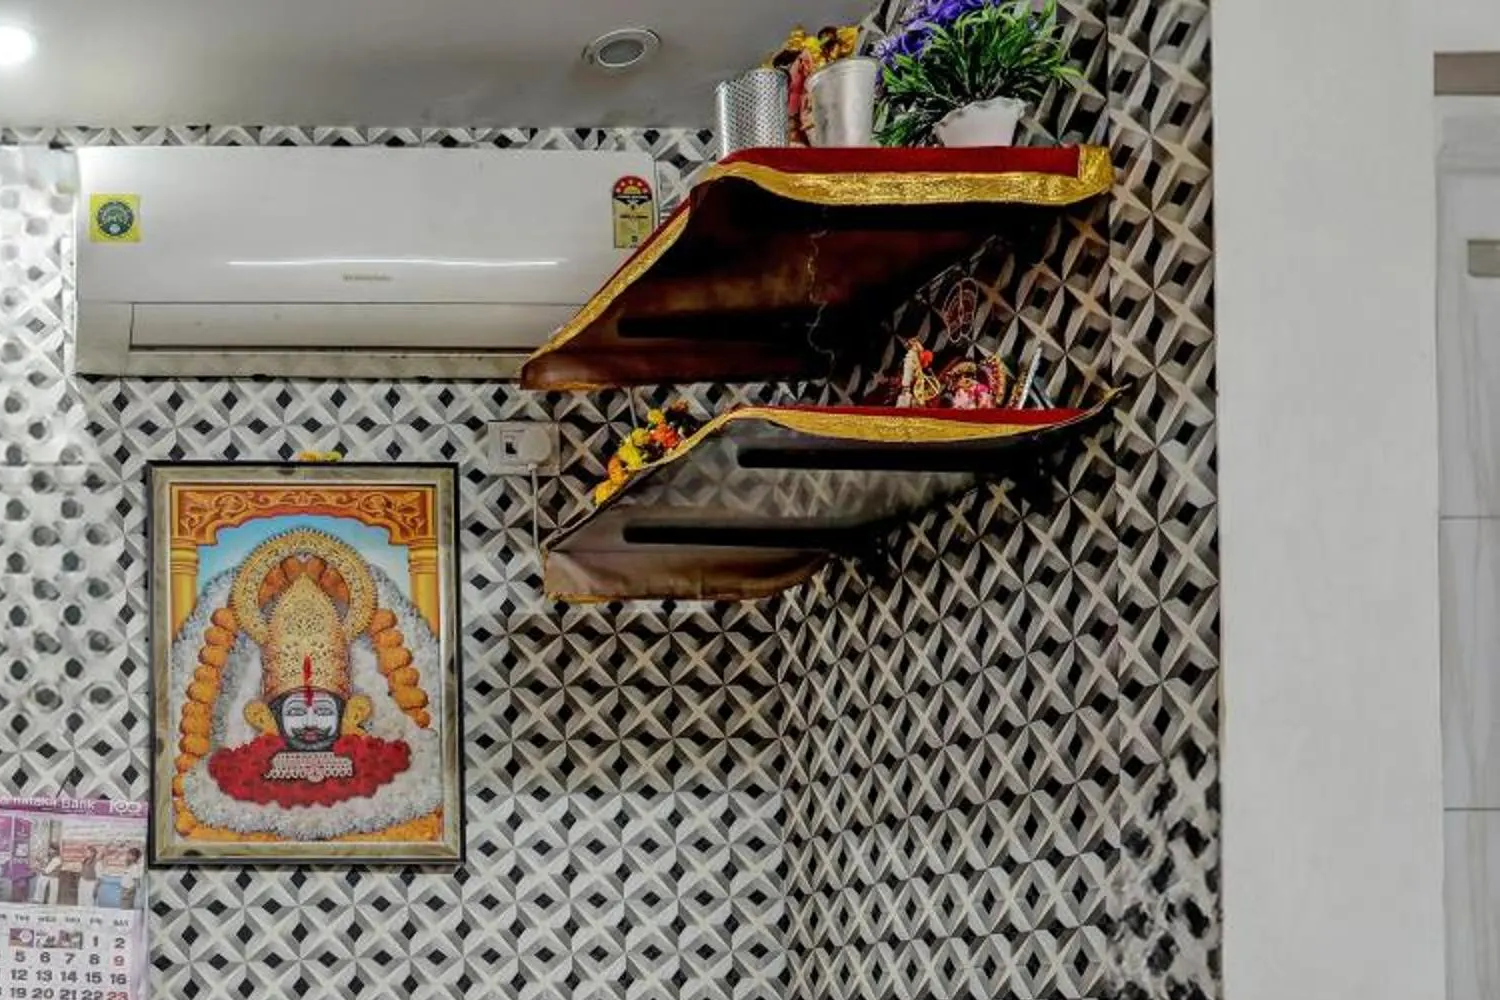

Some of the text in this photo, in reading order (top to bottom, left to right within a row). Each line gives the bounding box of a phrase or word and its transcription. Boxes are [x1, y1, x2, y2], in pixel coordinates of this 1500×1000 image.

[92, 936, 99, 947] 1
[115, 938, 125, 948] 2
[15, 951, 26, 962] 5
[40, 952, 51, 963] 6
[64, 953, 75, 964] 7
[89, 954, 100, 965] 8
[114, 955, 125, 966] 9
[11, 969, 28, 981] 12
[36, 970, 53, 982] 13
[60, 971, 78, 983] 14
[85, 972, 102, 983] 15
[110, 973, 127, 985] 16
[11, 987, 26, 998] 19
[32, 988, 54, 999] 20
[60, 989, 77, 1000] 21
